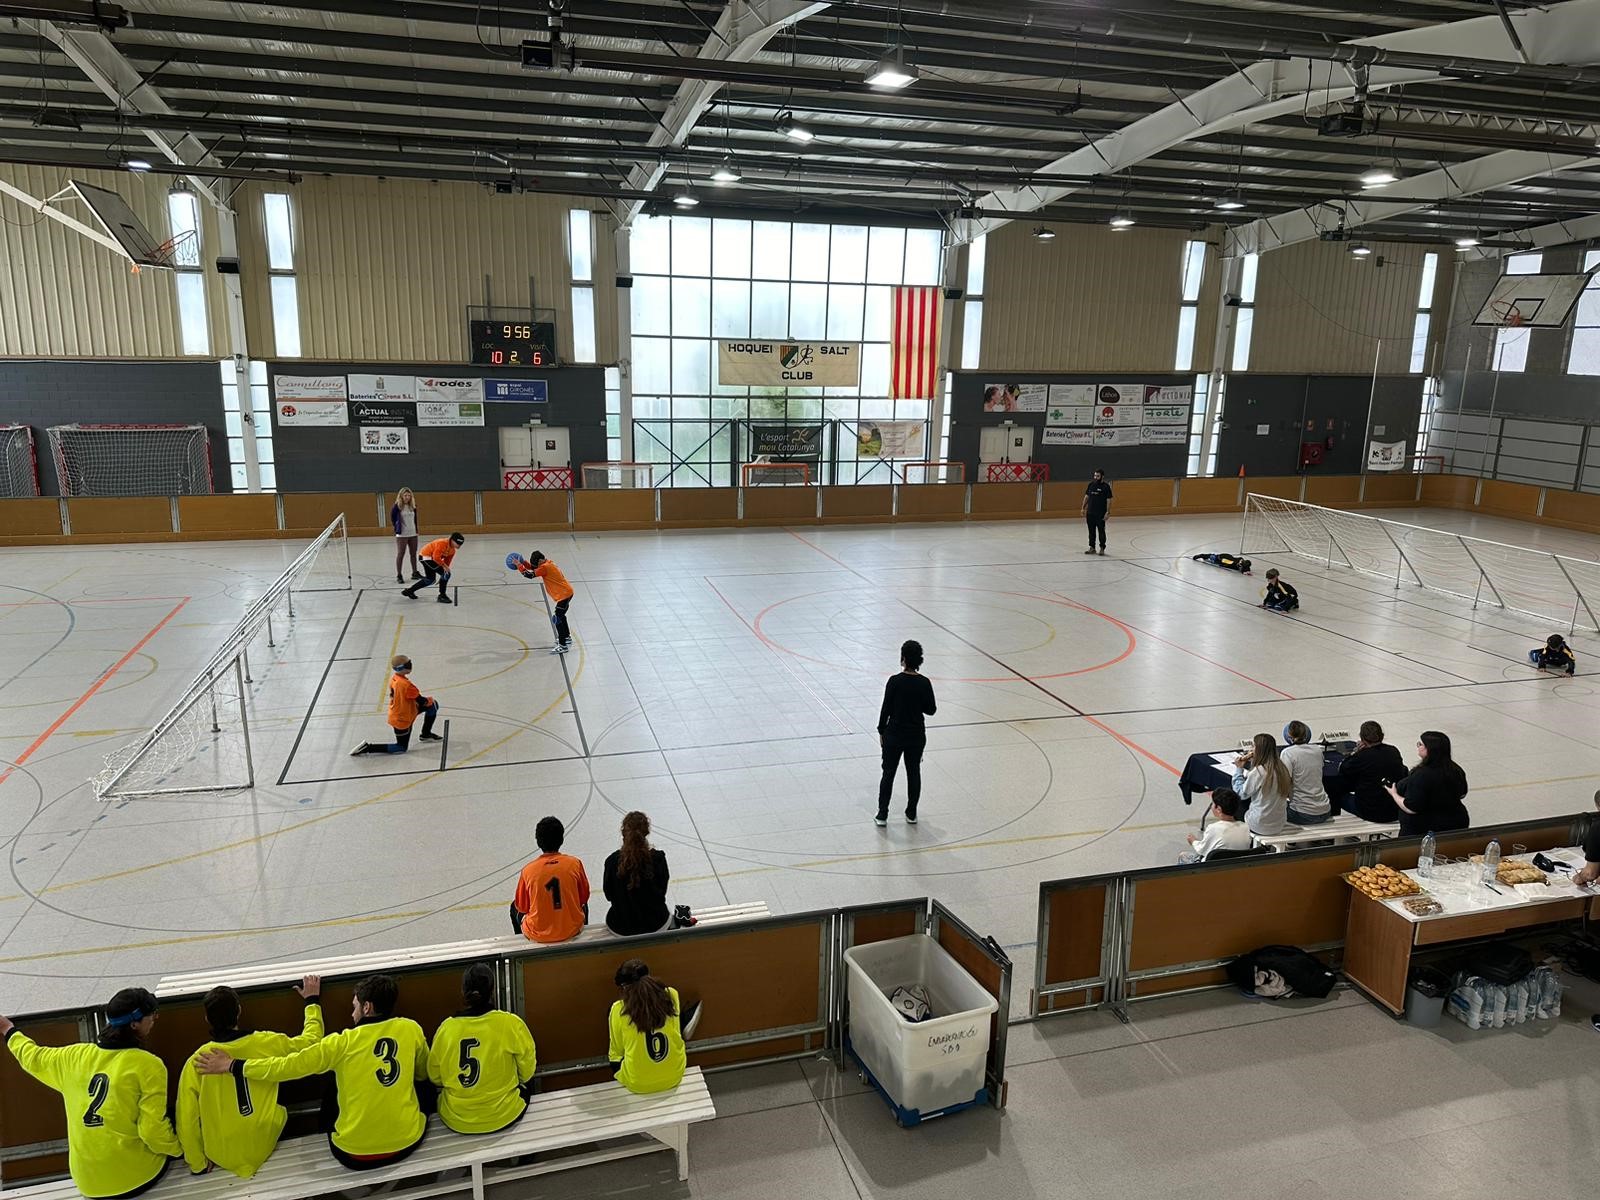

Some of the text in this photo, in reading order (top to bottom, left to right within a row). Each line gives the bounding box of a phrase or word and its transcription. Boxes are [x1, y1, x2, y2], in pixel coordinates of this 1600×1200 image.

[491, 350, 541, 365] 10 2 6
[728, 343, 850, 355] HOQUEI SALT
[781, 371, 813, 380] CLUB
[359, 408, 390, 416] ACTUAL
[760, 433, 789, 443] L'esport
[544, 876, 562, 910] 1
[374, 1038, 400, 1087] 3
[645, 1028, 669, 1063] 6
[458, 1038, 480, 1088] 5
[83, 1073, 109, 1127] 2
[234, 1070, 254, 1116] 1
